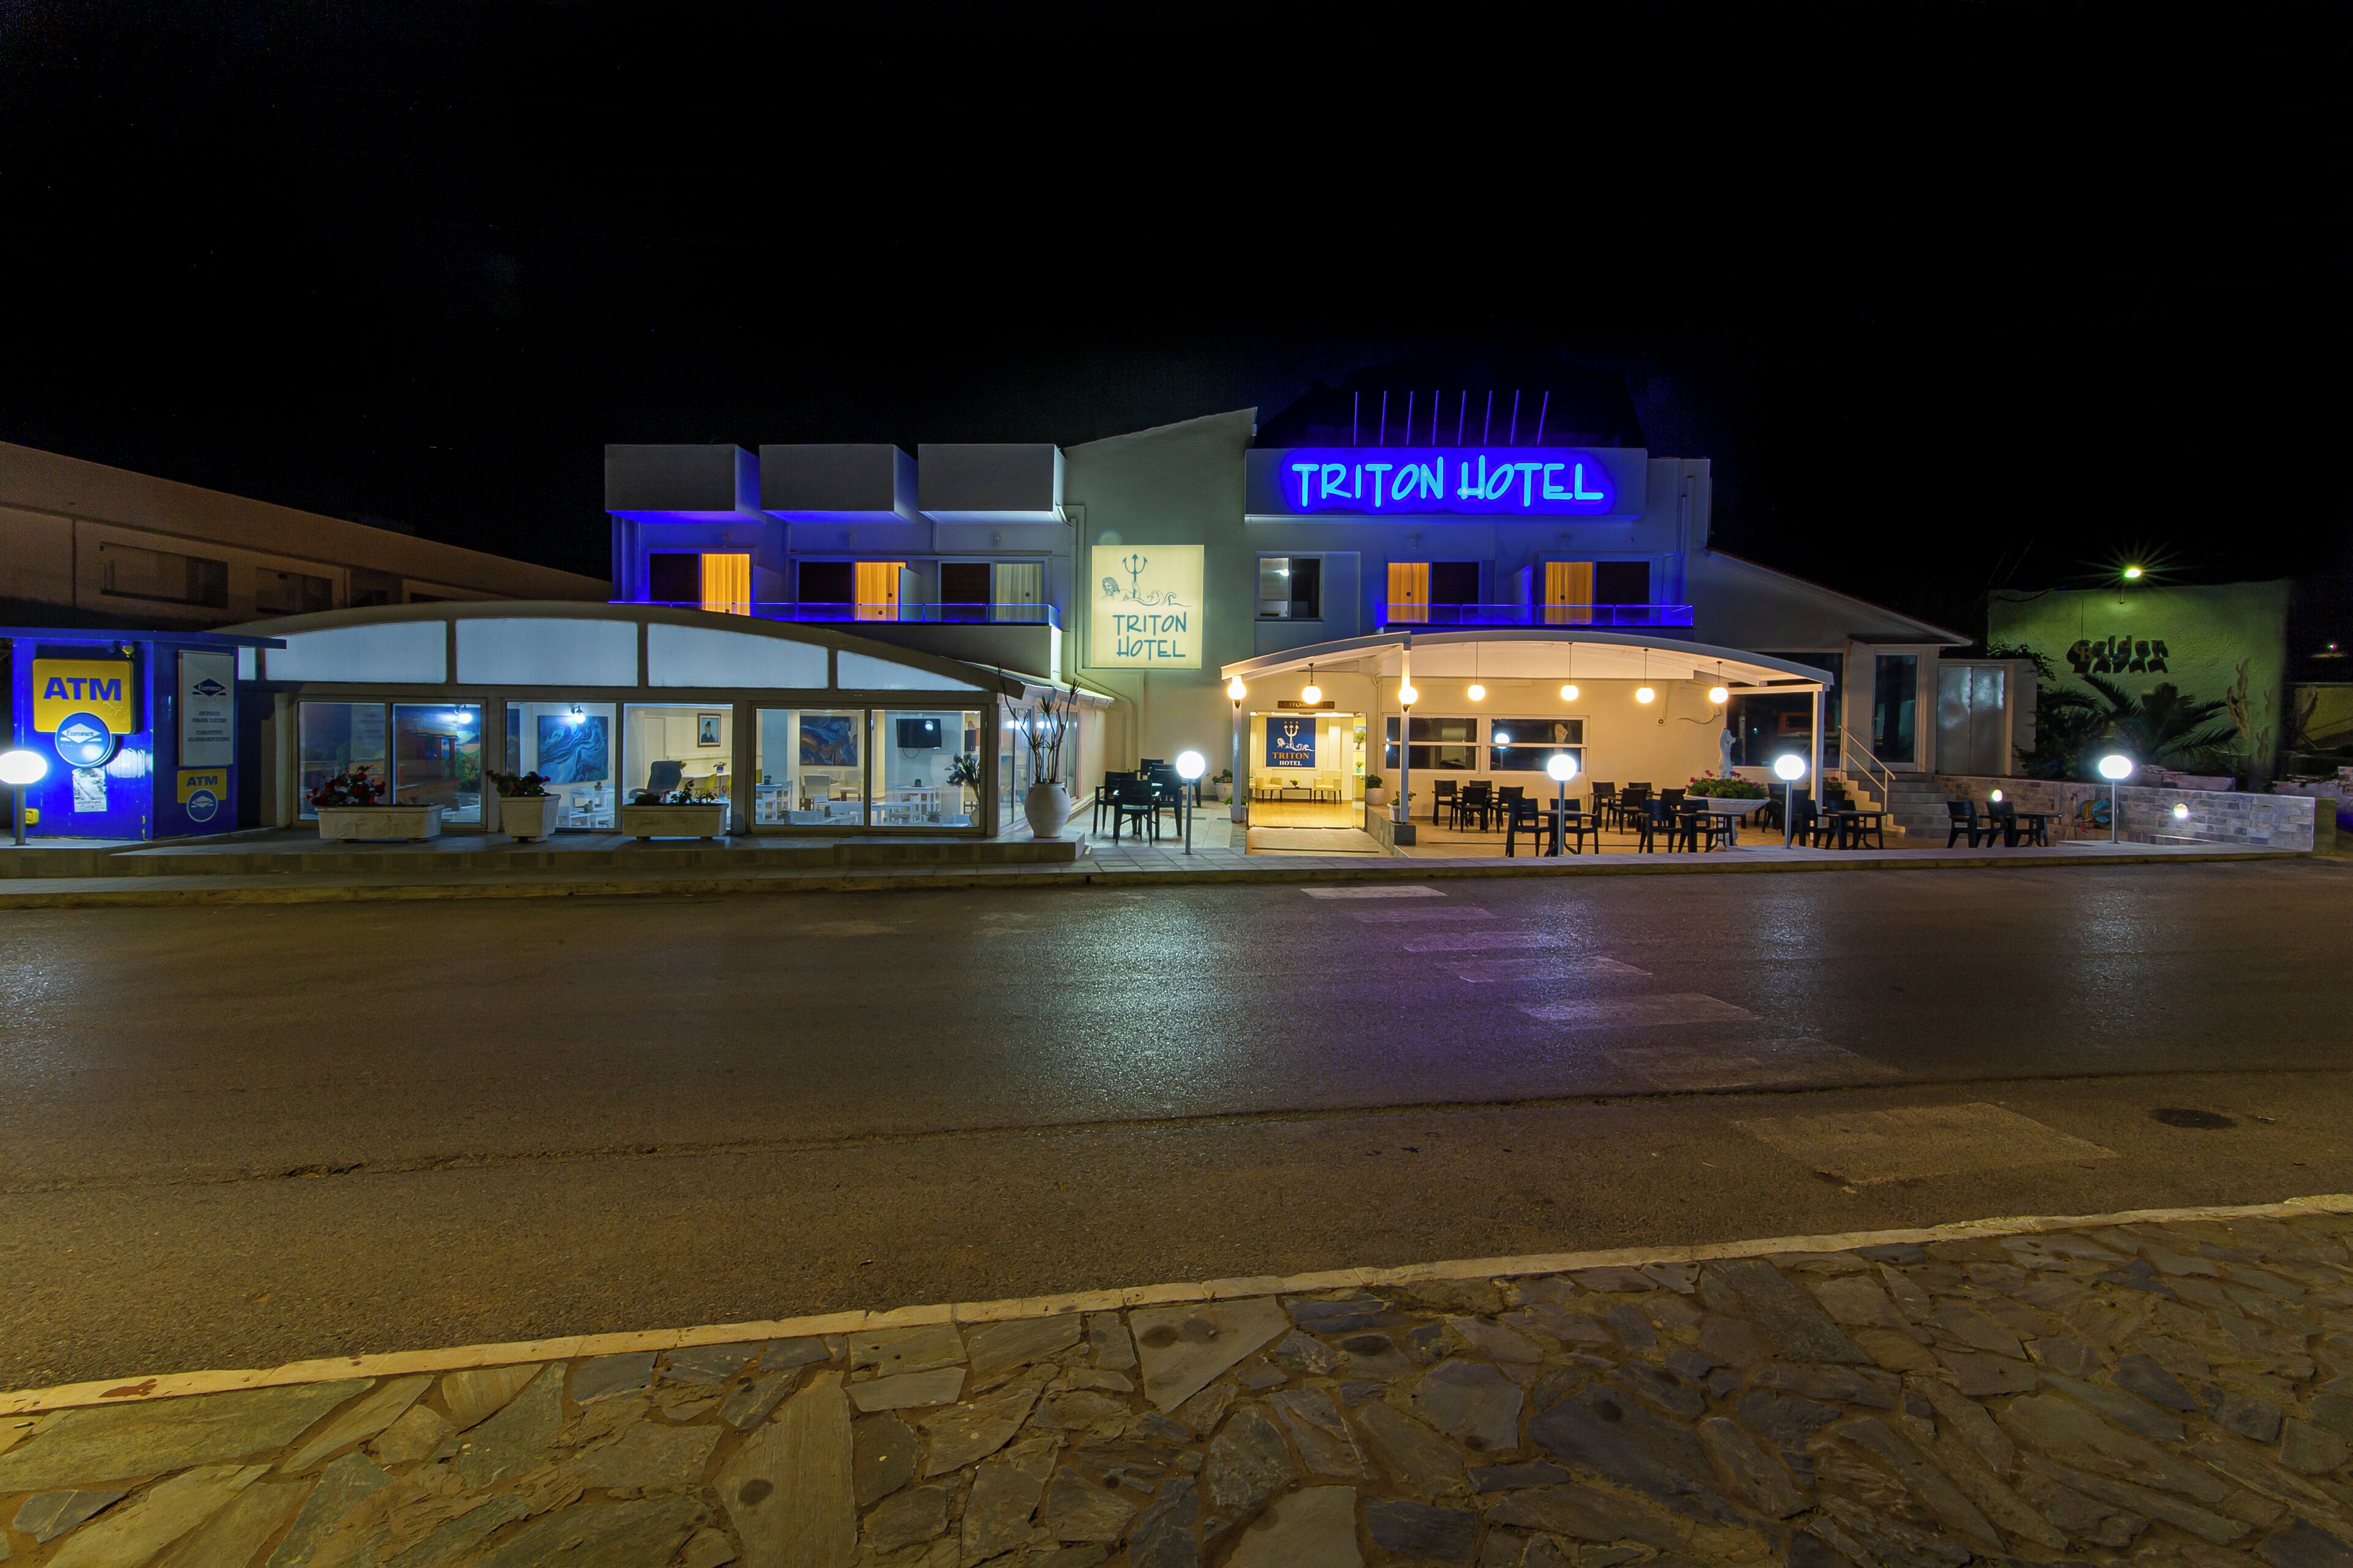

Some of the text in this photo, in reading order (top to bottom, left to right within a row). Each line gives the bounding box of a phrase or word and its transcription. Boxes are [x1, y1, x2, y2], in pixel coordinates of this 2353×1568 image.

[1292, 455, 1604, 507] TRITON HOTEL
[1112, 611, 1187, 636] TRITON
[1116, 635, 1186, 661] HOTEL
[2067, 635, 2169, 661] Golden
[43, 676, 122, 702] ATM
[186, 775, 218, 787] ATM
